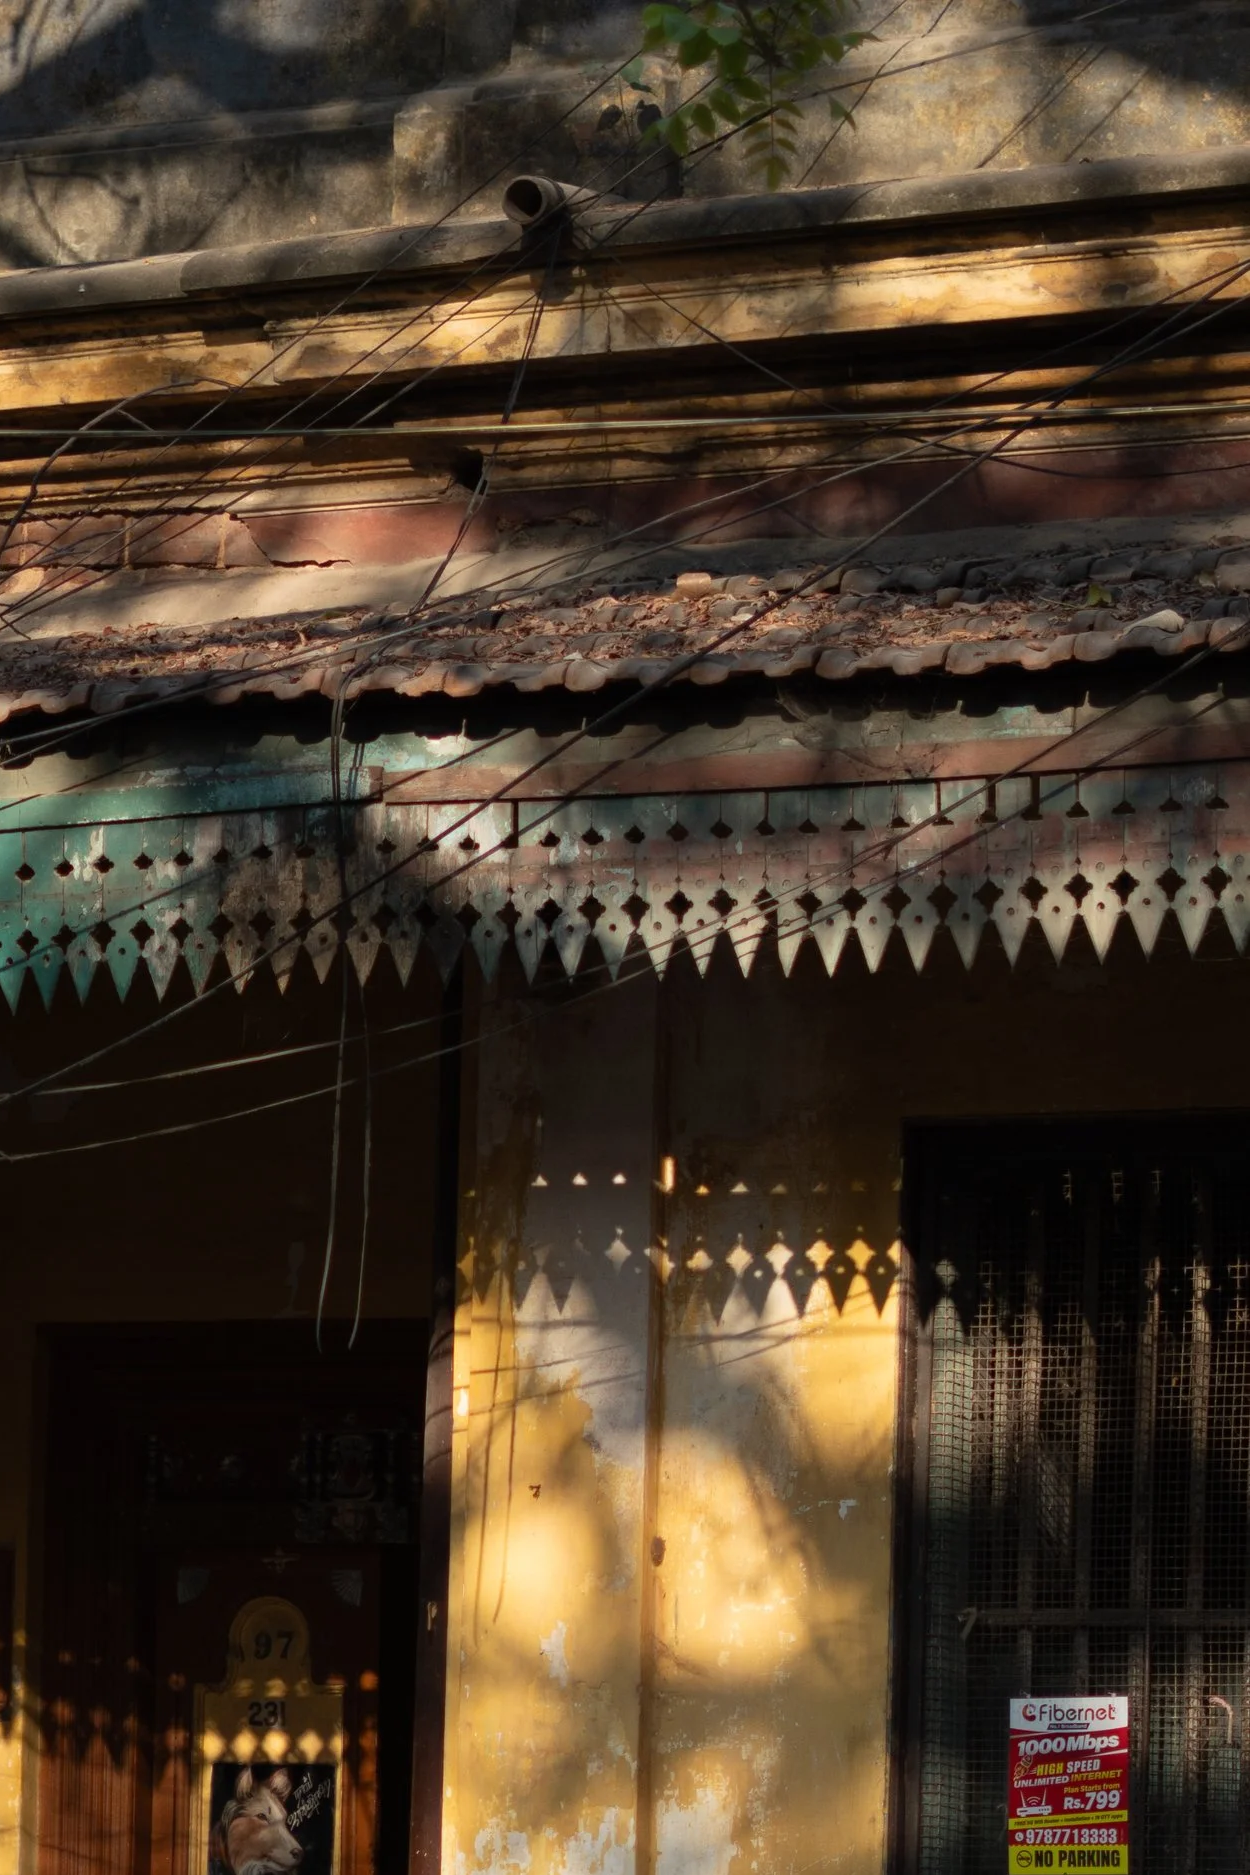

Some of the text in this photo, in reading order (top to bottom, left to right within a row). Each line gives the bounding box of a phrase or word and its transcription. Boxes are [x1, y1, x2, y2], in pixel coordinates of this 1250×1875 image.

[253, 1630, 296, 1660] 97
[249, 1701, 286, 1727] 231
[1036, 1759, 1101, 1776] HIGH SPEED
[1014, 1769, 1123, 1789] UNLIMITED INTERNET
[1064, 1783, 1120, 1794] Plan Starts from
[1025, 1828, 1117, 1844] 9787713333
[1034, 1850, 1121, 1868] NO PARKING
